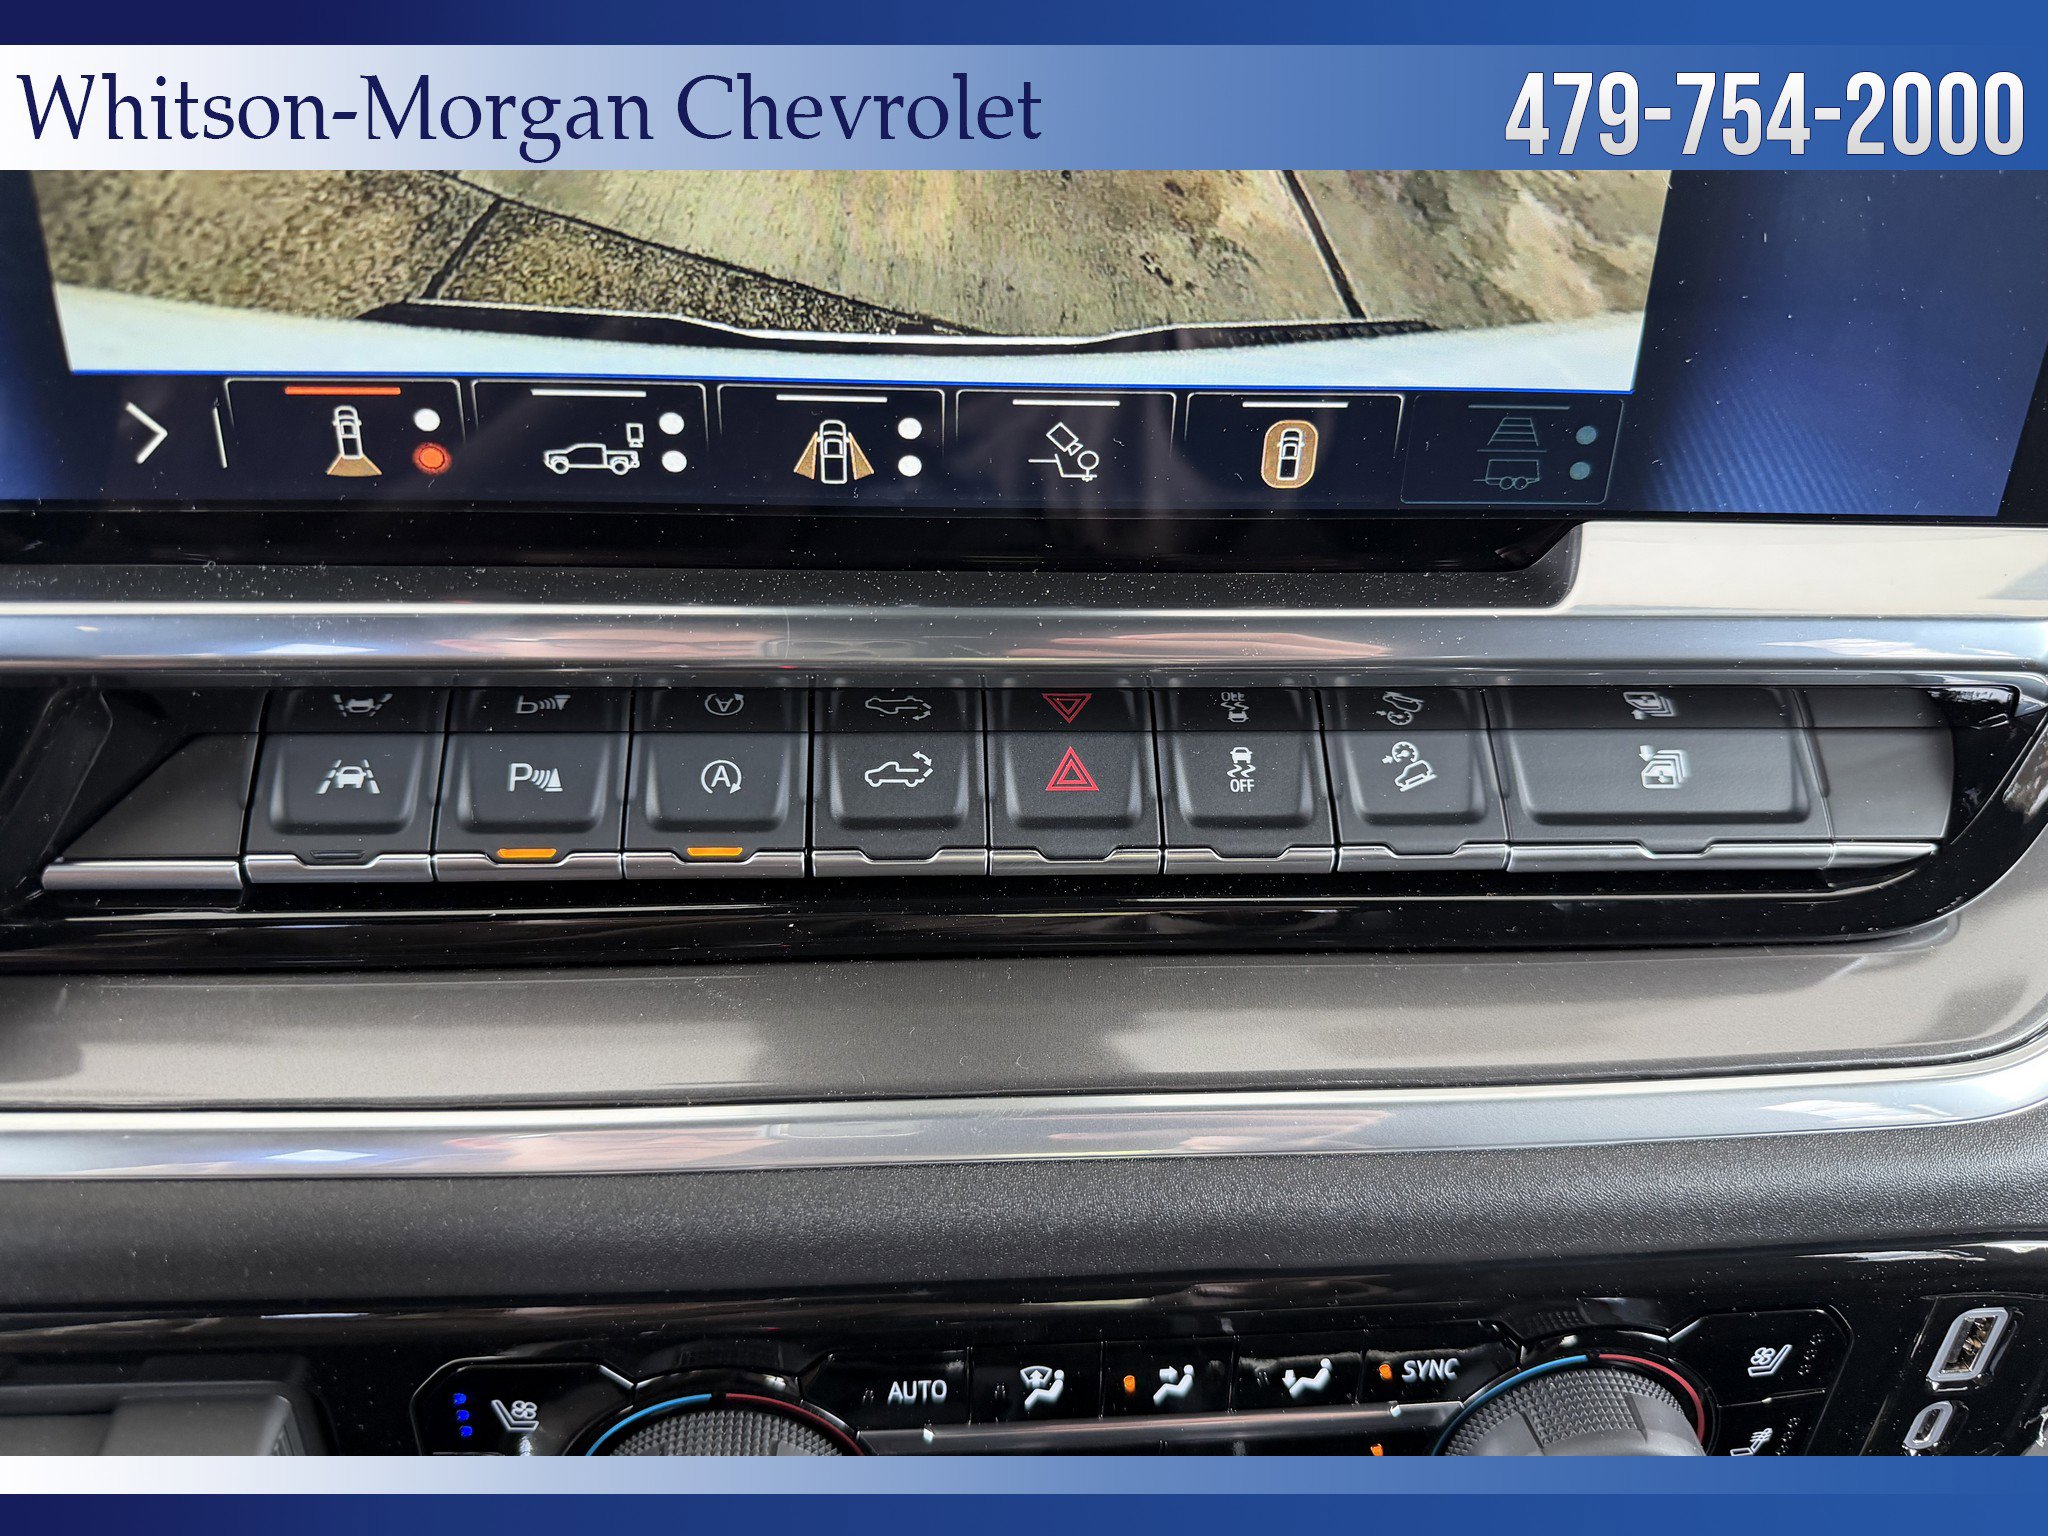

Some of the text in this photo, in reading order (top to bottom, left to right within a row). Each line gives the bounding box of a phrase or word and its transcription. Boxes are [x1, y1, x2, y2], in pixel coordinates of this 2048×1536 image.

[1229, 778, 1255, 793] OFF
[1401, 1357, 1460, 1383] SYNC
[886, 1379, 948, 1405] AUTO
